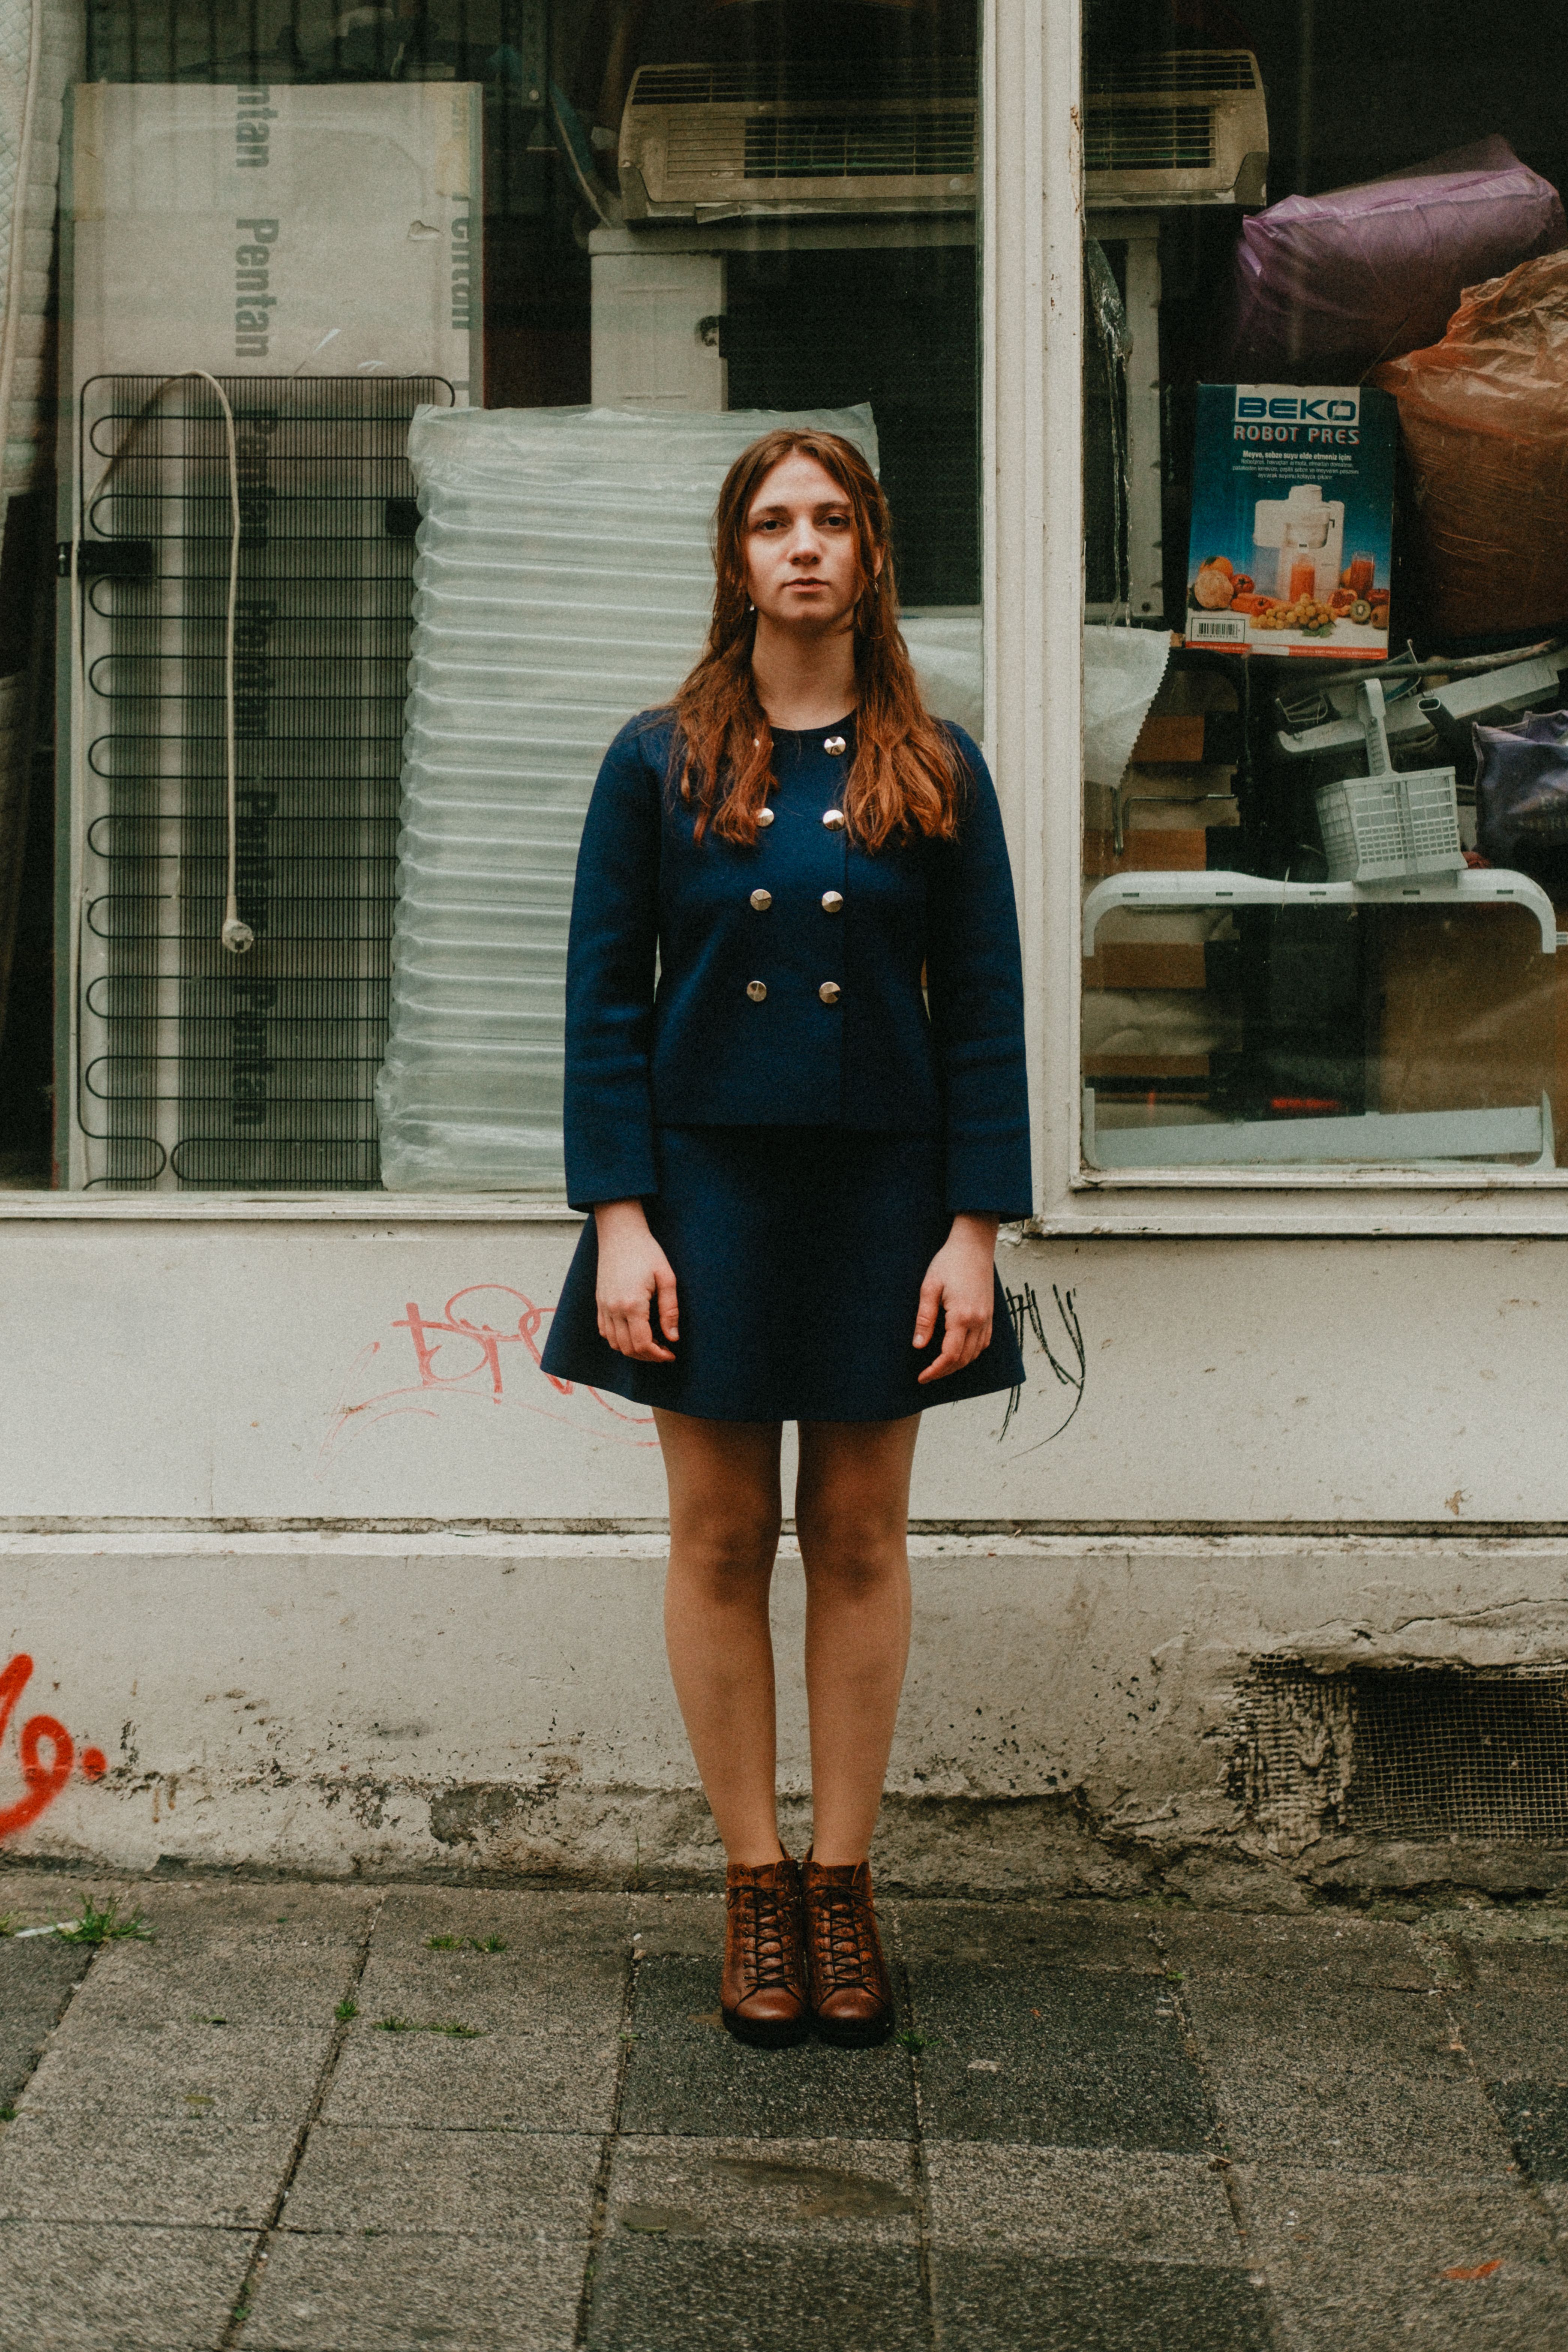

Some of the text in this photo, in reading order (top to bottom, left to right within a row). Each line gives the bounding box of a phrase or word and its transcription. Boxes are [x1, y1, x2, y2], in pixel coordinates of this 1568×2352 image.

[235, 219, 279, 357] Pentan
[1238, 397, 1356, 421] BEKO
[1234, 425, 1360, 445] ROBOT PRES
[1243, 450, 1264, 459] Meyve,
